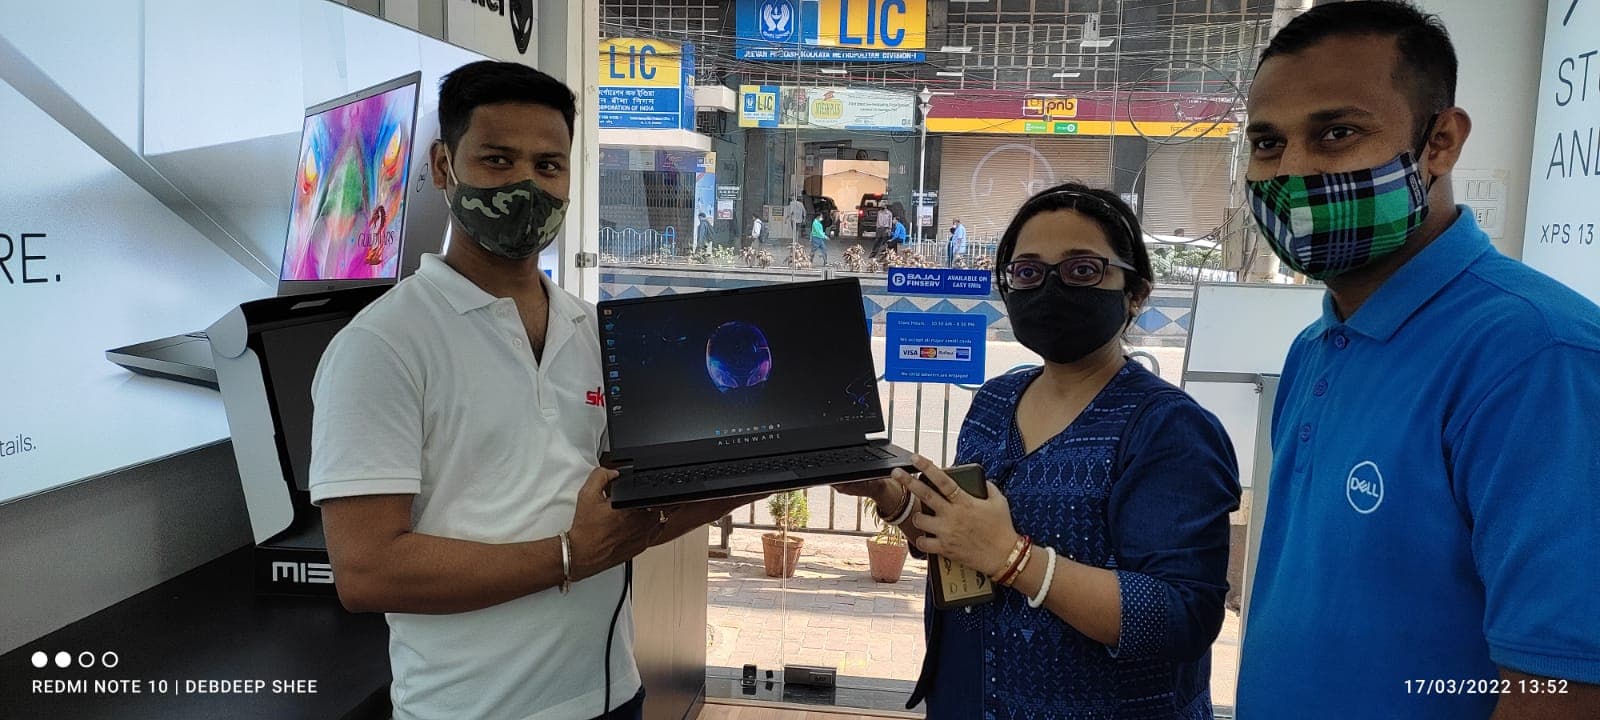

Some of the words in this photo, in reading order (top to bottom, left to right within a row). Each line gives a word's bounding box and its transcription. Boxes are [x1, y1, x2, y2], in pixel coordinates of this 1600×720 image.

[839, 0, 906, 47] LIC
[609, 44, 657, 80] LIC
[1555, 50, 1600, 107] ST
[757, 95, 773, 111] LIC
[1047, 98, 1074, 114] pnb
[1546, 128, 1600, 180] AN
[1541, 224, 1571, 245] XPS
[1578, 224, 1594, 245] 13
[718, 433, 780, 446] ALIENWARE
[1350, 477, 1379, 497] DELL
